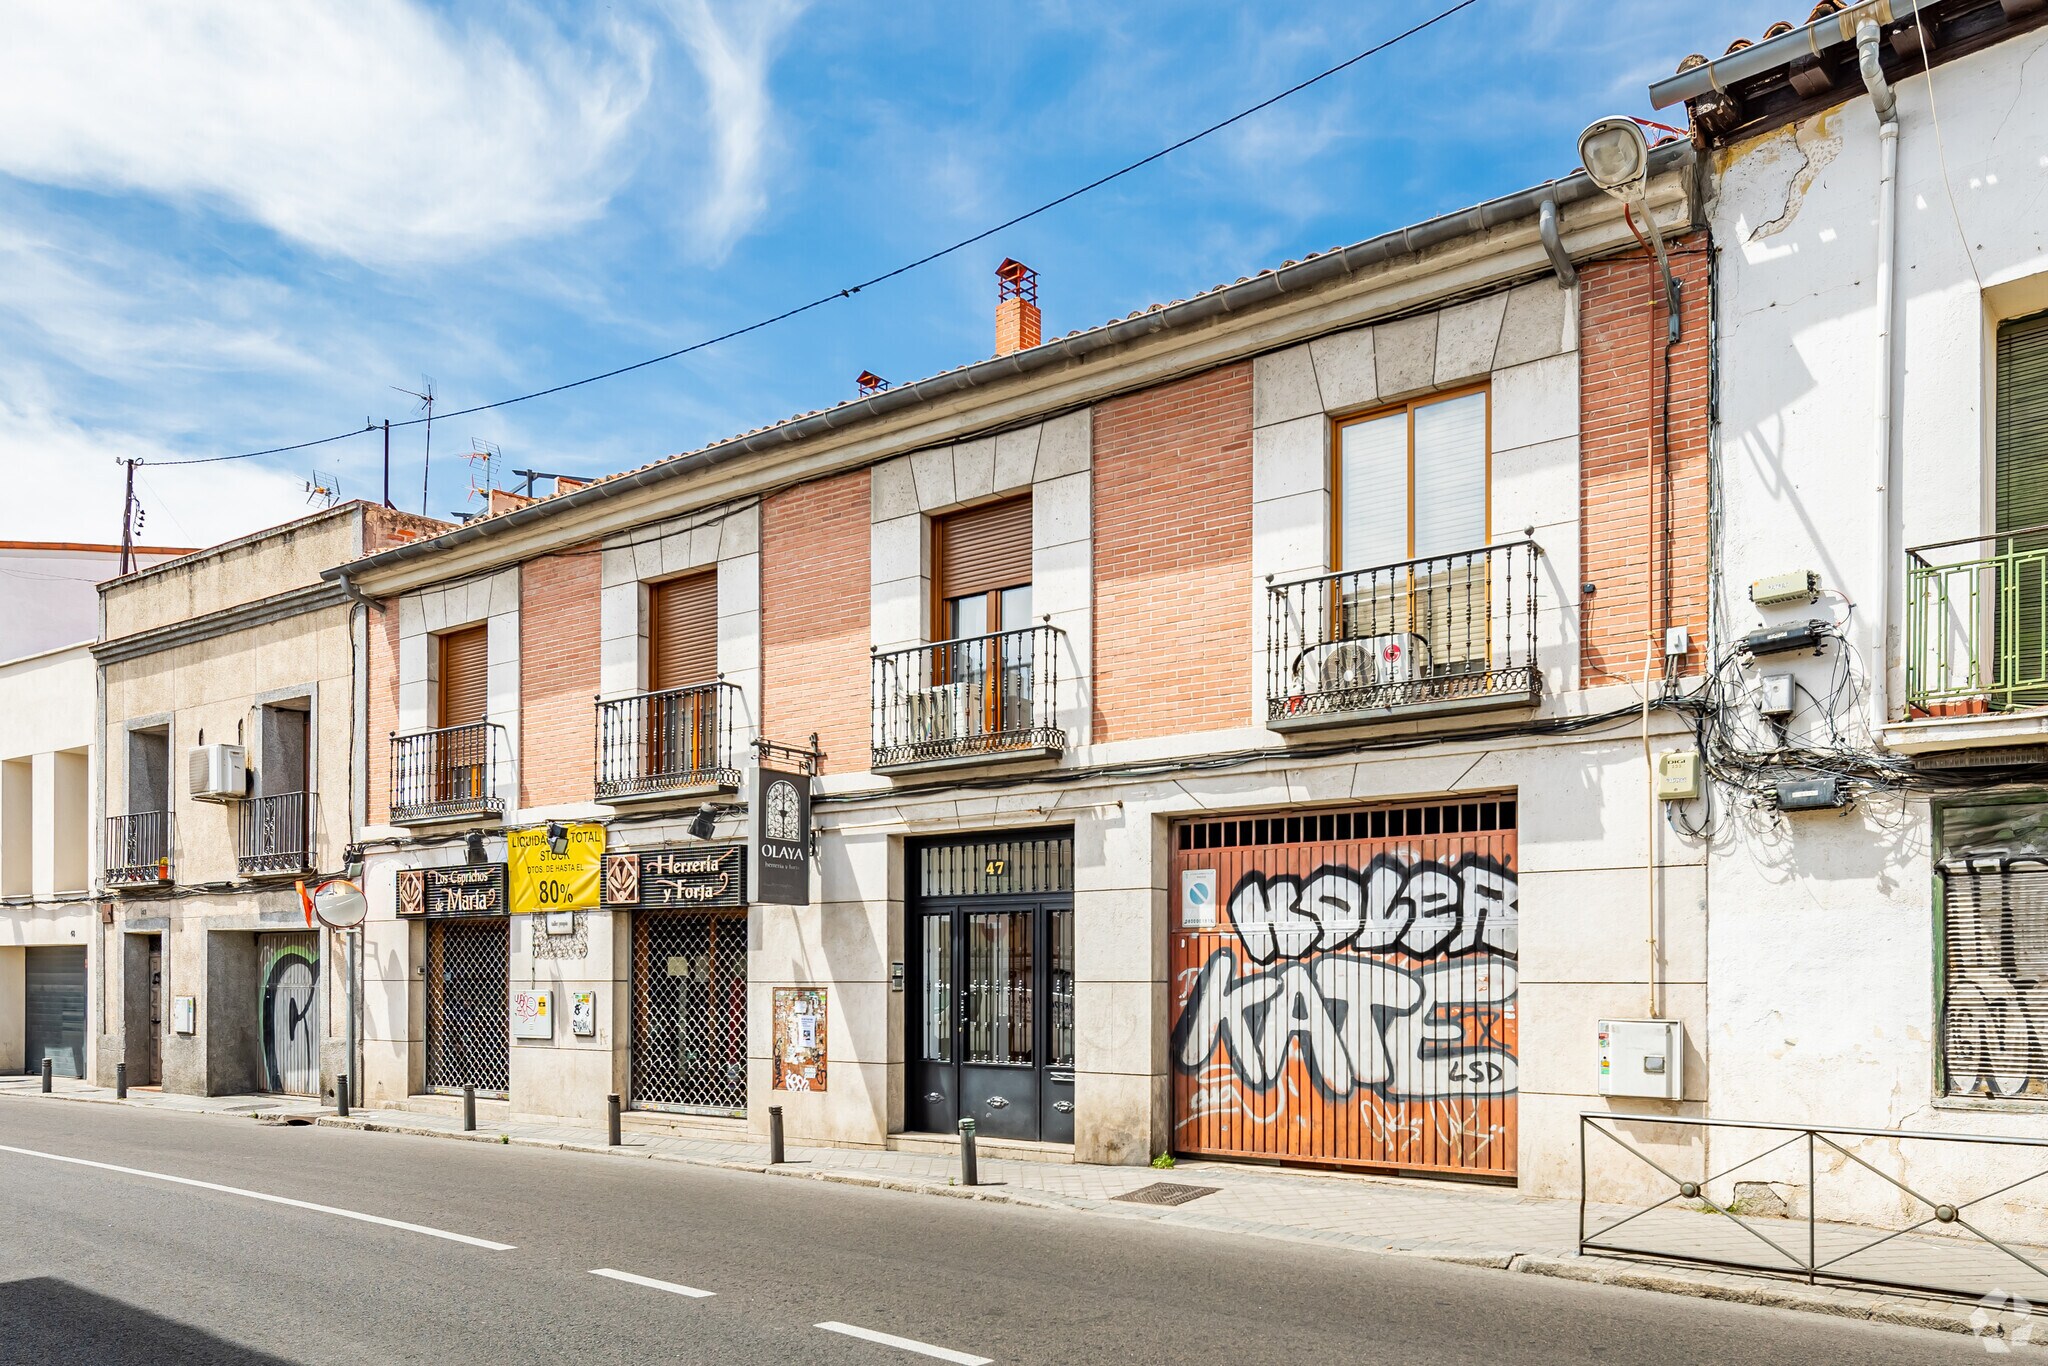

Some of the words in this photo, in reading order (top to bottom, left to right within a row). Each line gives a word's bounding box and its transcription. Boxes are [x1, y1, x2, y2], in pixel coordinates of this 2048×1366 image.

[571, 831, 601, 843] TOTAL
[761, 843, 804, 861] OLAYA
[546, 864, 554, 873] DE
[556, 863, 575, 873] HASTA
[576, 863, 584, 871] EL
[652, 855, 724, 874] Herrería
[986, 861, 1004, 875] 47
[432, 871, 448, 885] Los
[451, 868, 490, 886] Caprichos
[539, 880, 574, 904] 80%
[663, 888, 672, 903] y
[669, 877, 718, 901] Forja
[435, 898, 445, 911] de
[445, 888, 491, 911] María
[1449, 1060, 1503, 1083] LSD
